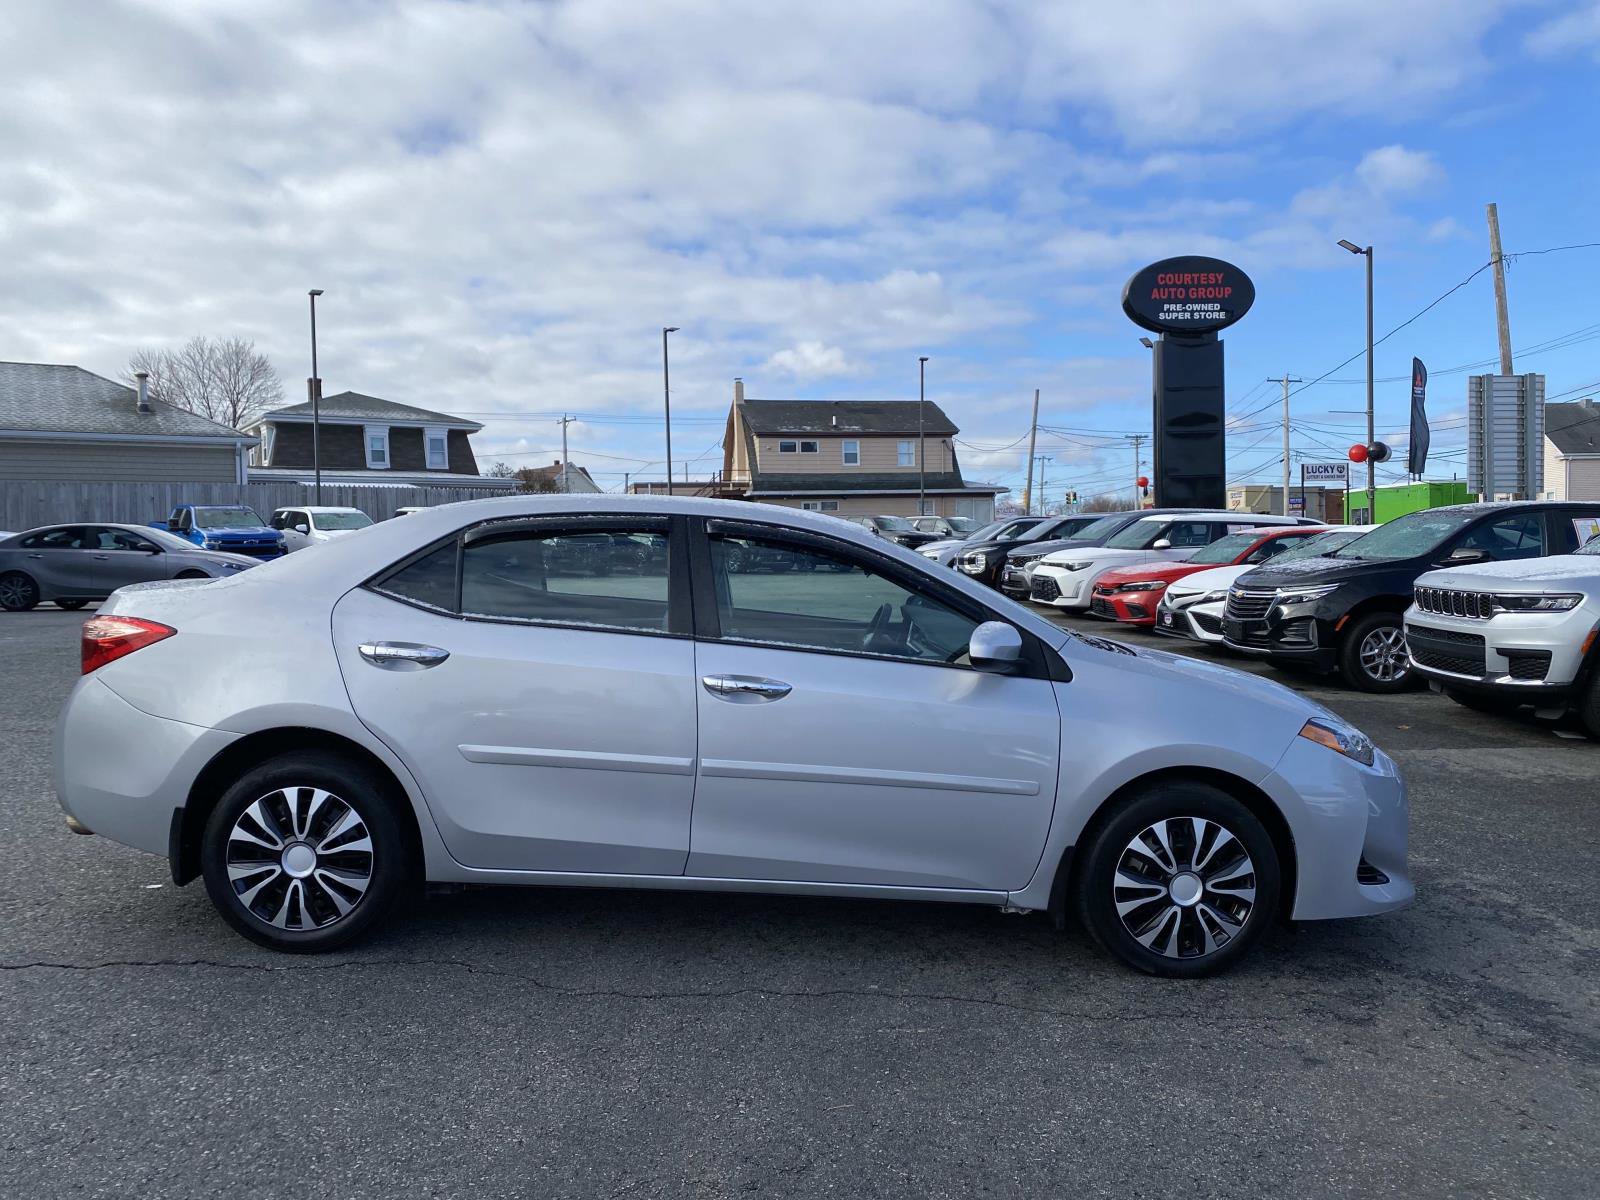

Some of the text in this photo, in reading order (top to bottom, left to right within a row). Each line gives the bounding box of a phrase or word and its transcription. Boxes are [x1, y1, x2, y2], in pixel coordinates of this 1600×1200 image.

[1157, 273, 1224, 284] COURTESY
[1151, 287, 1232, 299] AUTO GROUP
[1306, 465, 1335, 474] LUCKY
